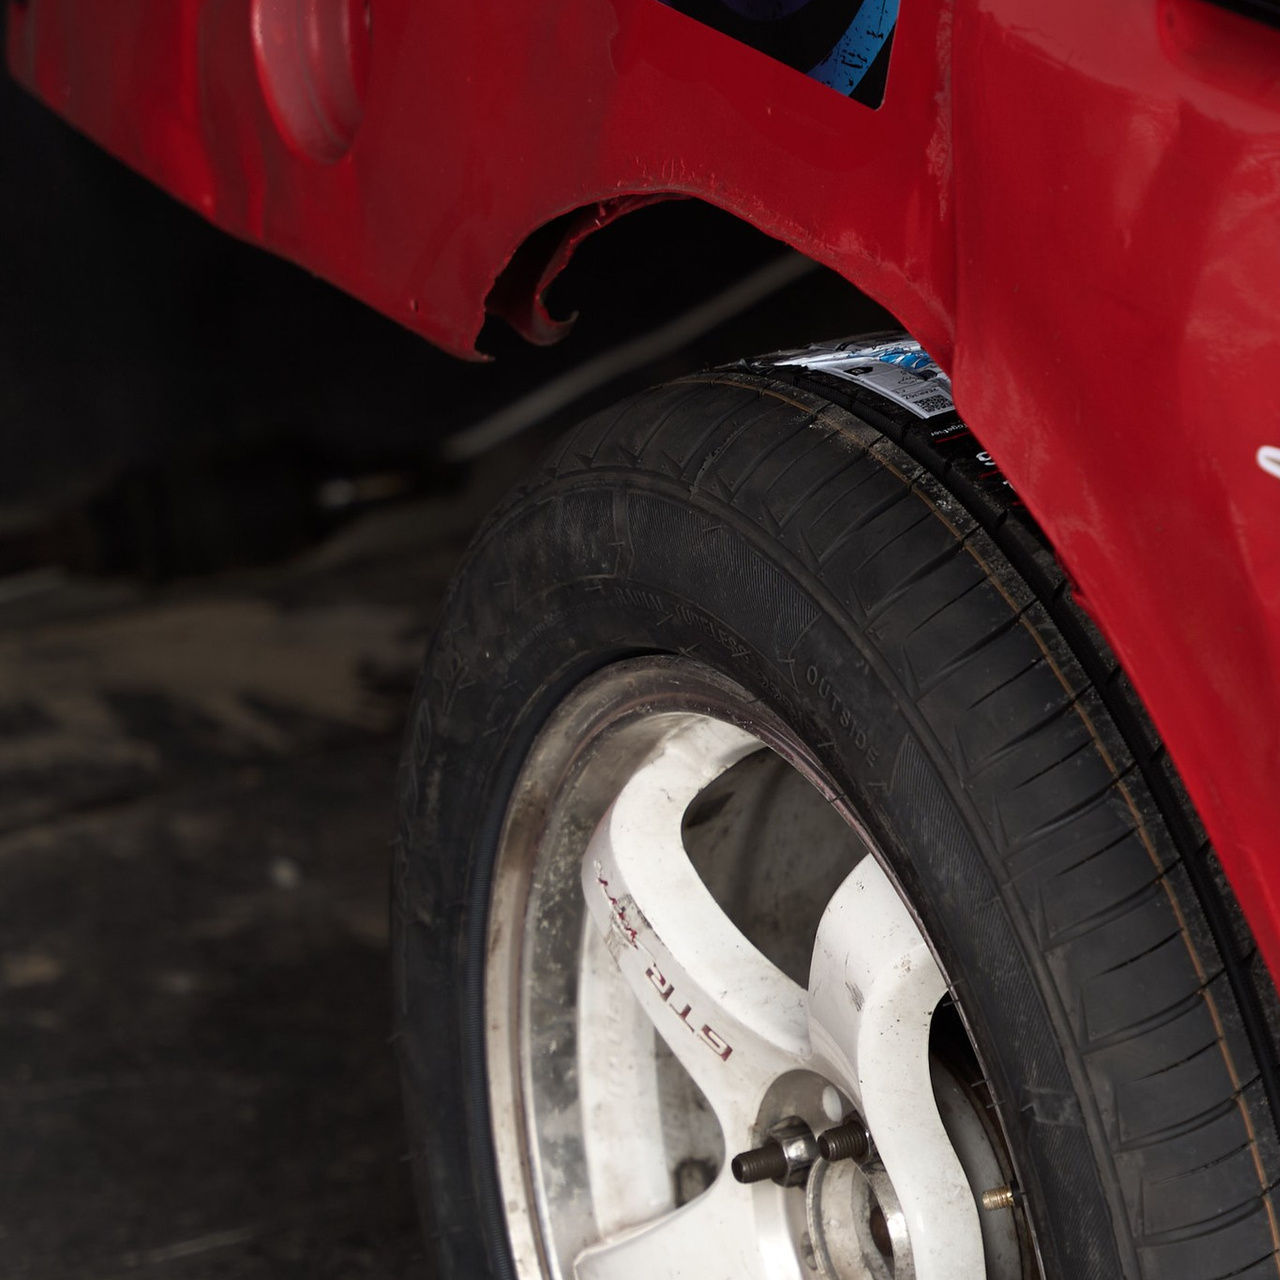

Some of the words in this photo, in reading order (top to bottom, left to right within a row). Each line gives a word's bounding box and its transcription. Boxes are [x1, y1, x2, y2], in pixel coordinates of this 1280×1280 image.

[930, 421, 968, 438] ogether
[806, 665, 880, 768] OUTSIDE
[645, 966, 734, 1062] GTR
